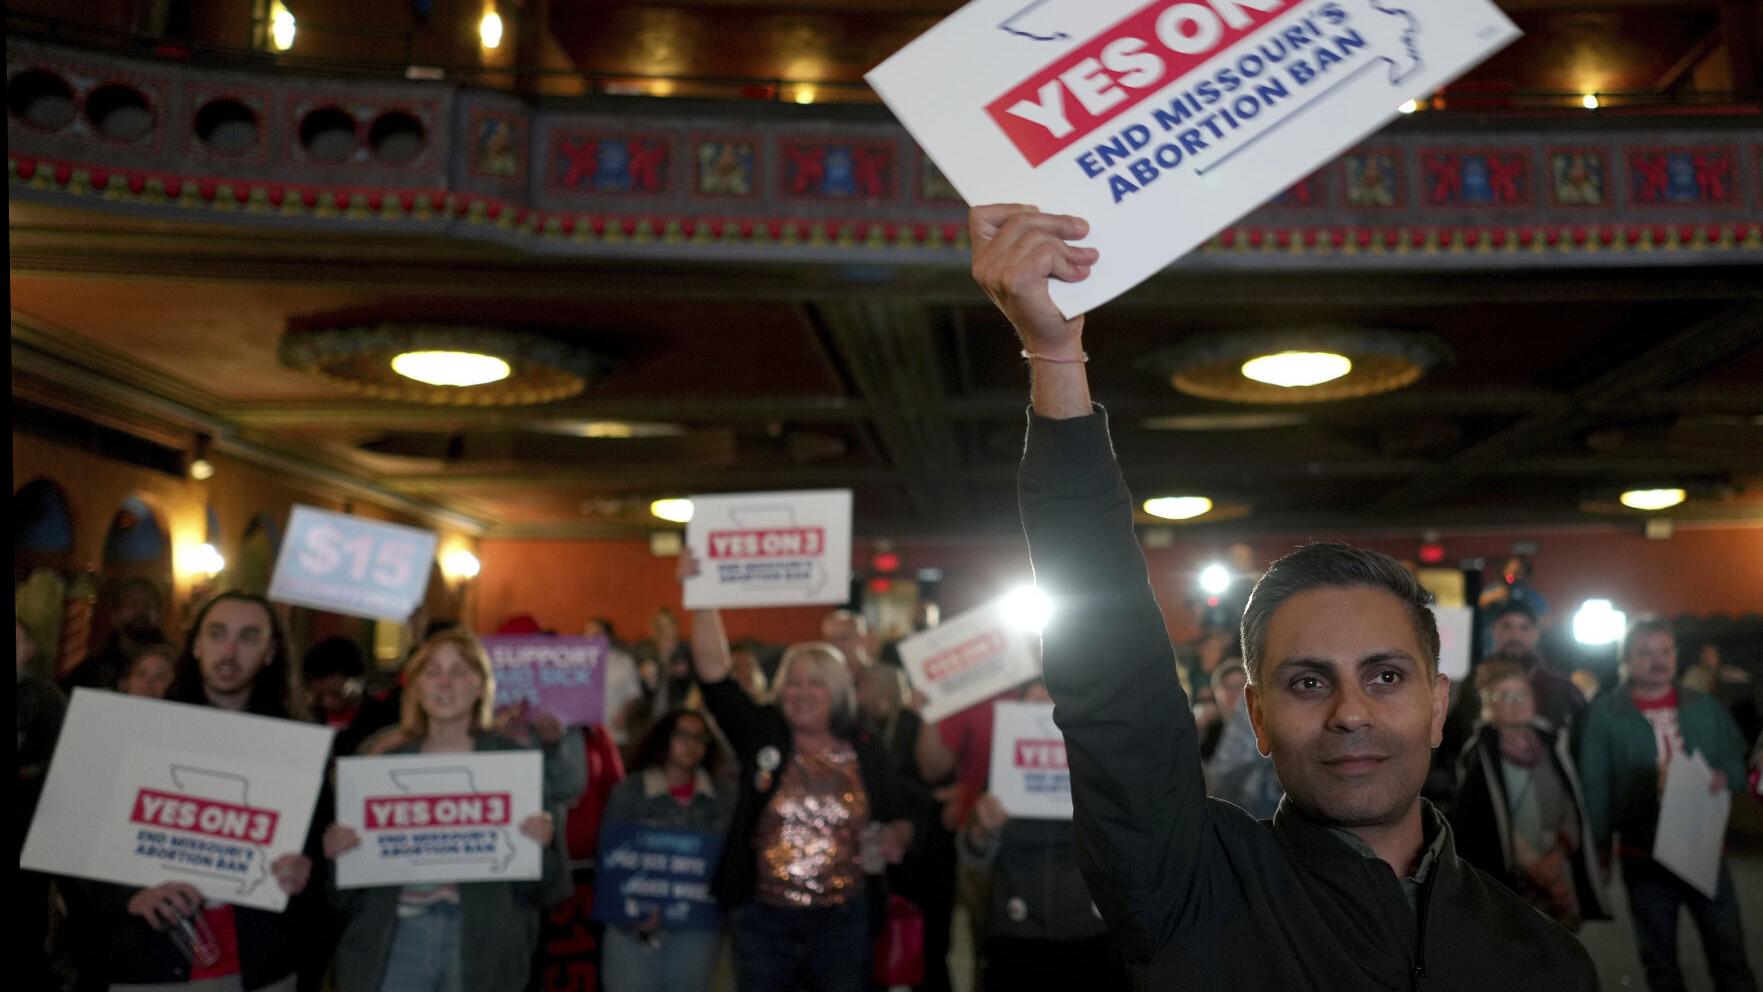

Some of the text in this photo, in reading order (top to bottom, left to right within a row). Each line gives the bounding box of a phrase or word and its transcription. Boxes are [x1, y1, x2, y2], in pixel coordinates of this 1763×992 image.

[1005, 37, 1166, 138] YES
[1075, 2, 1347, 179] END MISSOURI'S
[1107, 29, 1367, 203] ABORTION BAN
[298, 524, 415, 588] $15
[714, 535, 757, 556] YES
[763, 533, 801, 554] ON
[493, 645, 600, 668] SUPPORT
[142, 794, 271, 841] YES ON 3
[371, 797, 504, 827] YES ON 3
[136, 845, 249, 872] ABORTION BAN
[381, 845, 460, 857] ABORTION
